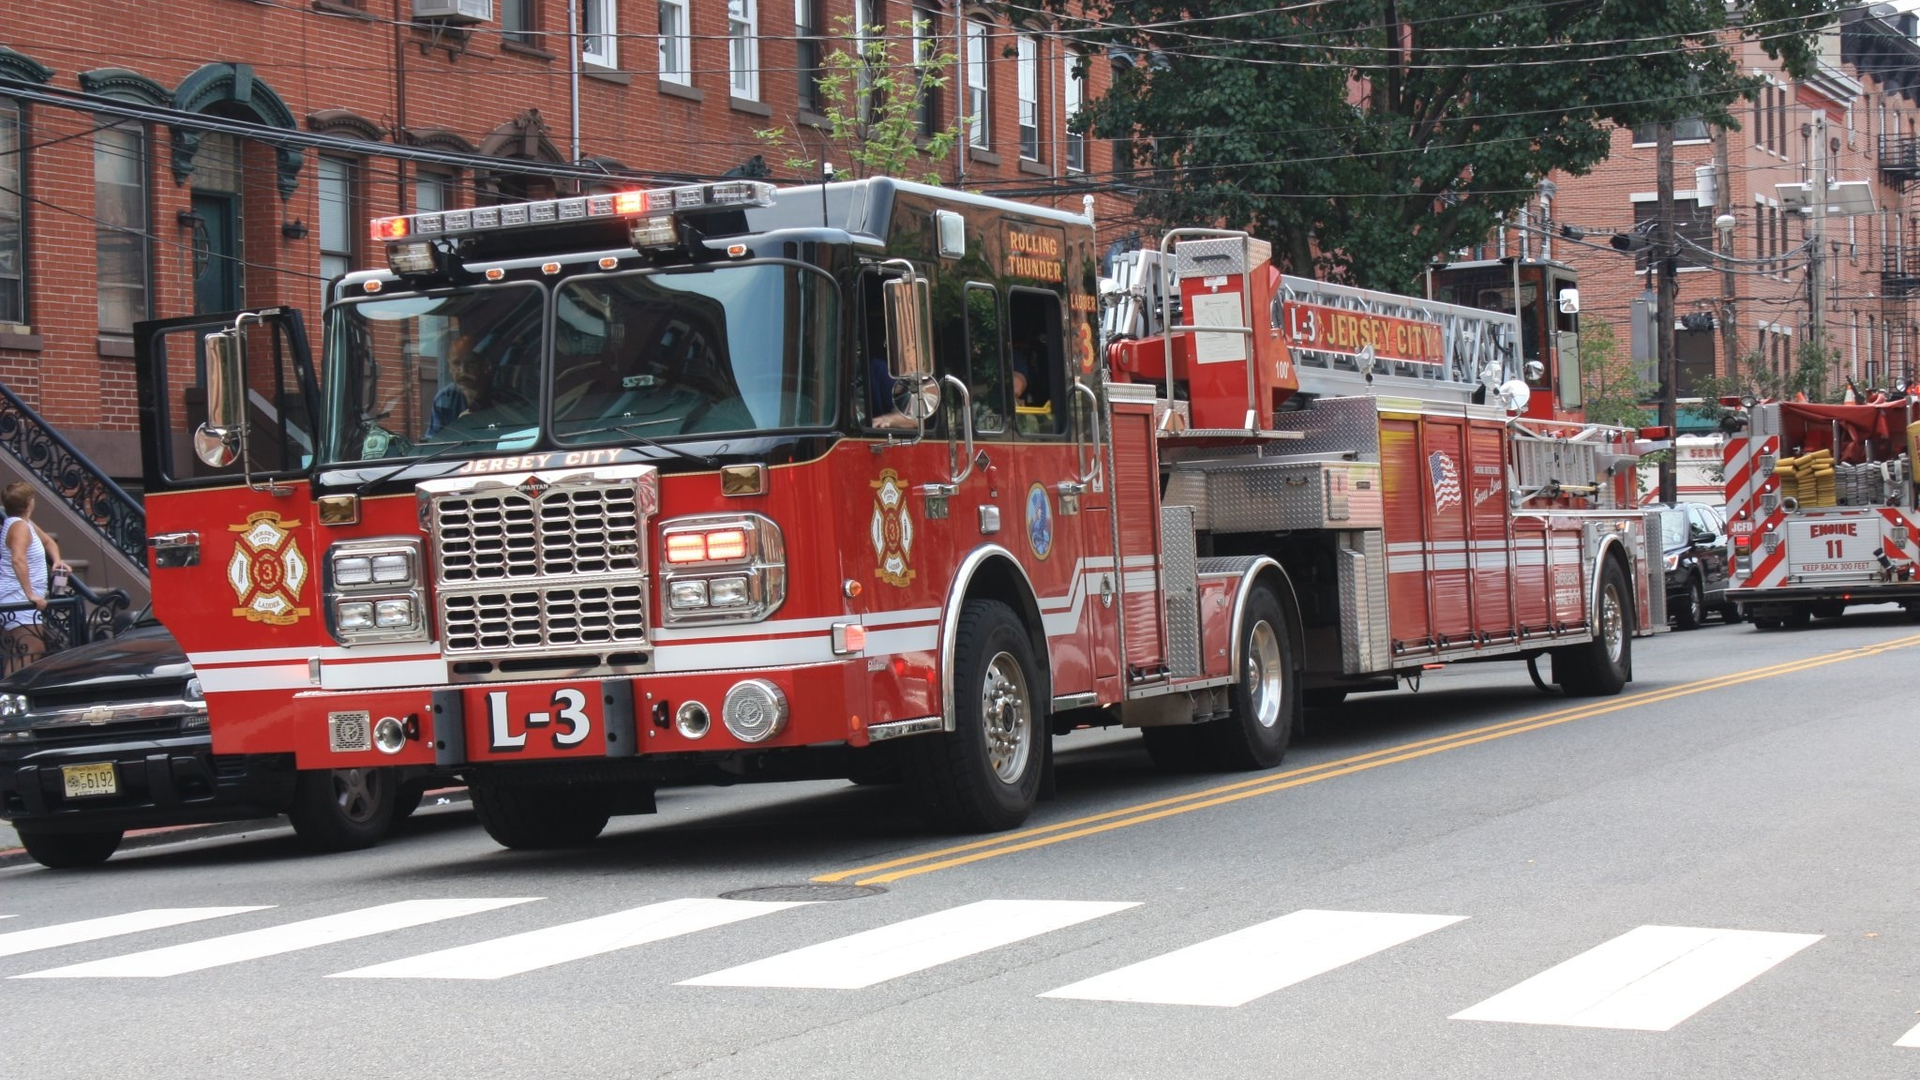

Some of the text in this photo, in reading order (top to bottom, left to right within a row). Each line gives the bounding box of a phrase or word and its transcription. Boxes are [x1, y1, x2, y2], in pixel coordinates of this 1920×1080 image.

[1009, 231, 1057, 255] ROLLING
[1008, 256, 1061, 282] THUNDER
[1070, 293, 1096, 312] LADDER
[1290, 307, 1431, 356] L-3 JERSEY CITY
[1081, 322, 1094, 374] 3
[460, 448, 622, 473] JERSEY CITY
[517, 484, 549, 492] SPARTAN
[252, 530, 276, 540] JERSEY
[889, 523, 895, 541] 3
[1731, 522, 1753, 533] JCFD
[1810, 523, 1857, 539] ENGINE
[1826, 540, 1843, 558] 11
[262, 563, 273, 580] 3
[1802, 562, 1870, 572] KEEP BACK 300 FEET
[257, 601, 281, 609] LADDER
[486, 688, 591, 752] L-3
[87, 771, 113, 788] 6192
